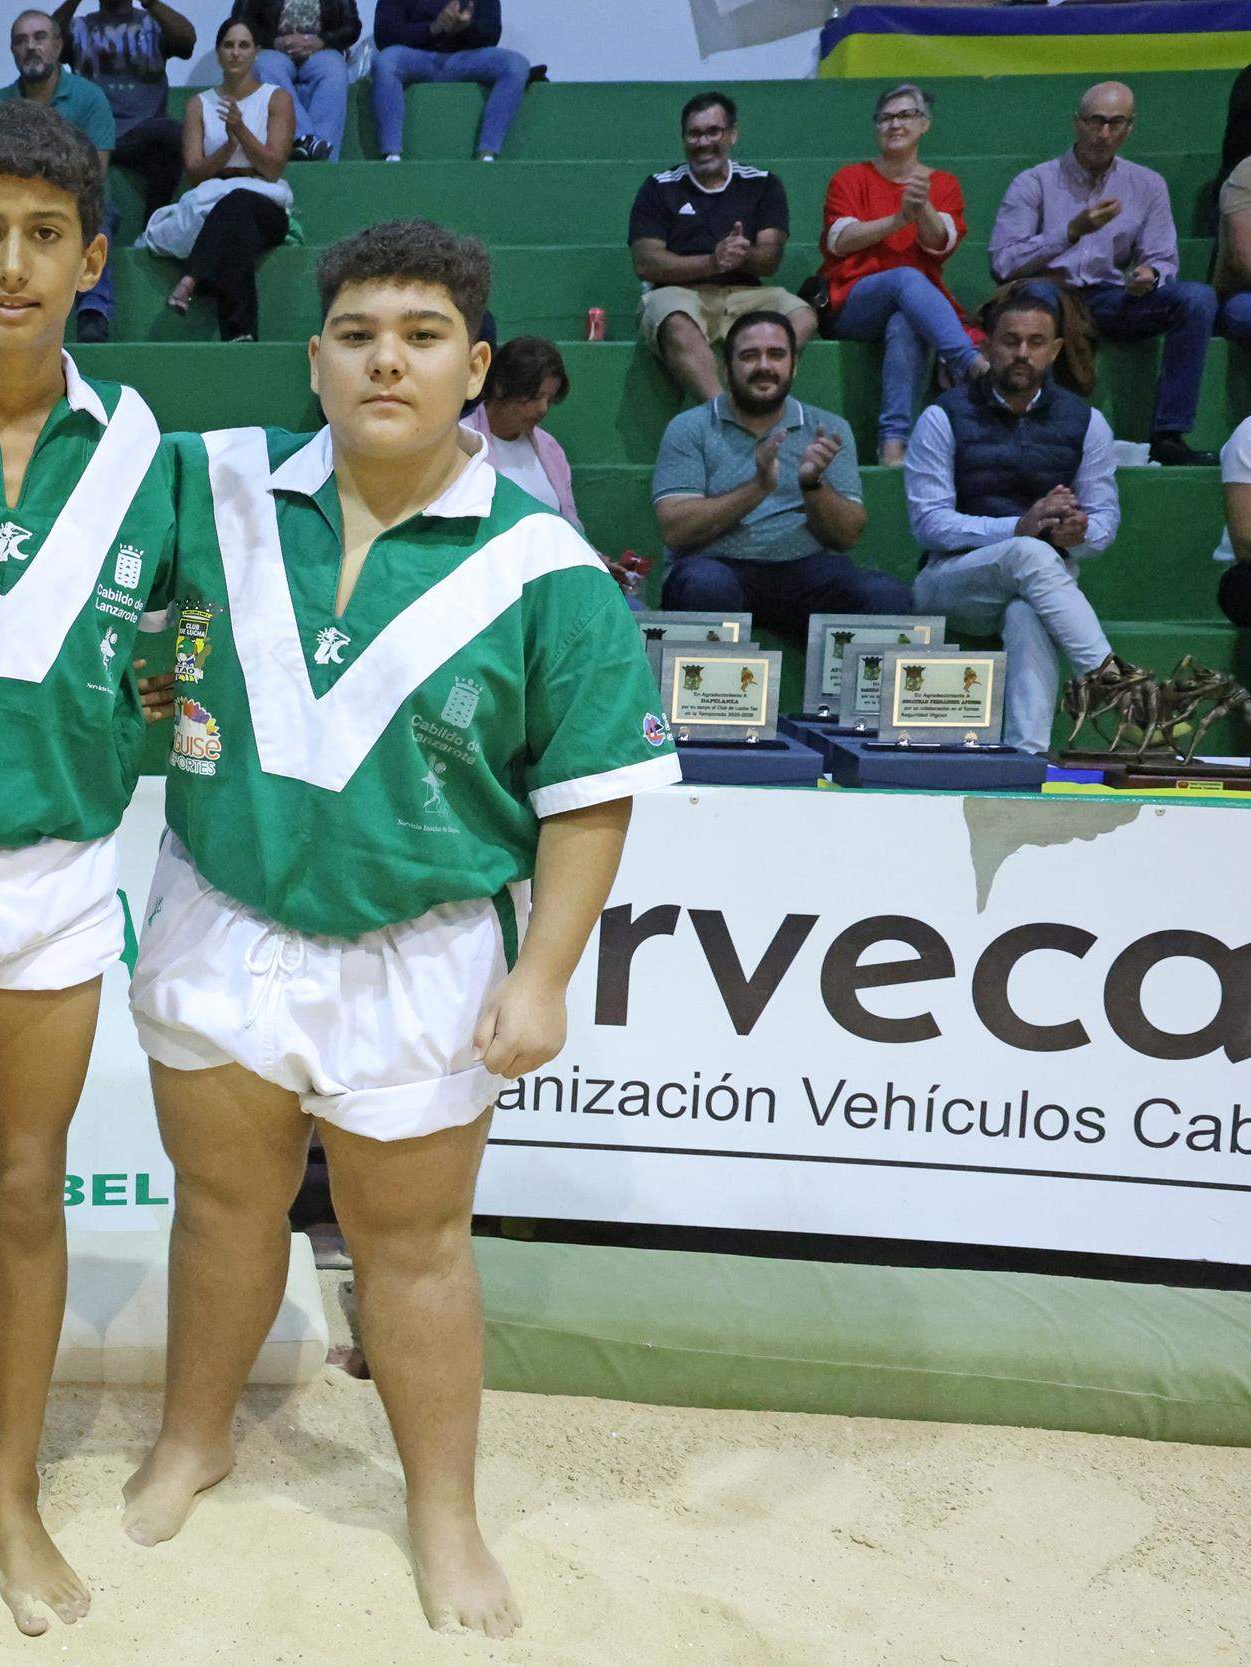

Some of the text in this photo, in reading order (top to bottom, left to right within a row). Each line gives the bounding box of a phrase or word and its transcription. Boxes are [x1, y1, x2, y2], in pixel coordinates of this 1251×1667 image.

[95, 596, 138, 624] Lanzarote
[97, 583, 144, 612] Cabildo de
[185, 622, 200, 630] CLUB
[186, 628, 205, 637] LUCHA
[177, 666, 195, 674] TAO
[410, 714, 480, 753] Cabildo de
[496, 1065, 776, 1124] anización
[801, 1075, 1106, 1144] Vehículos
